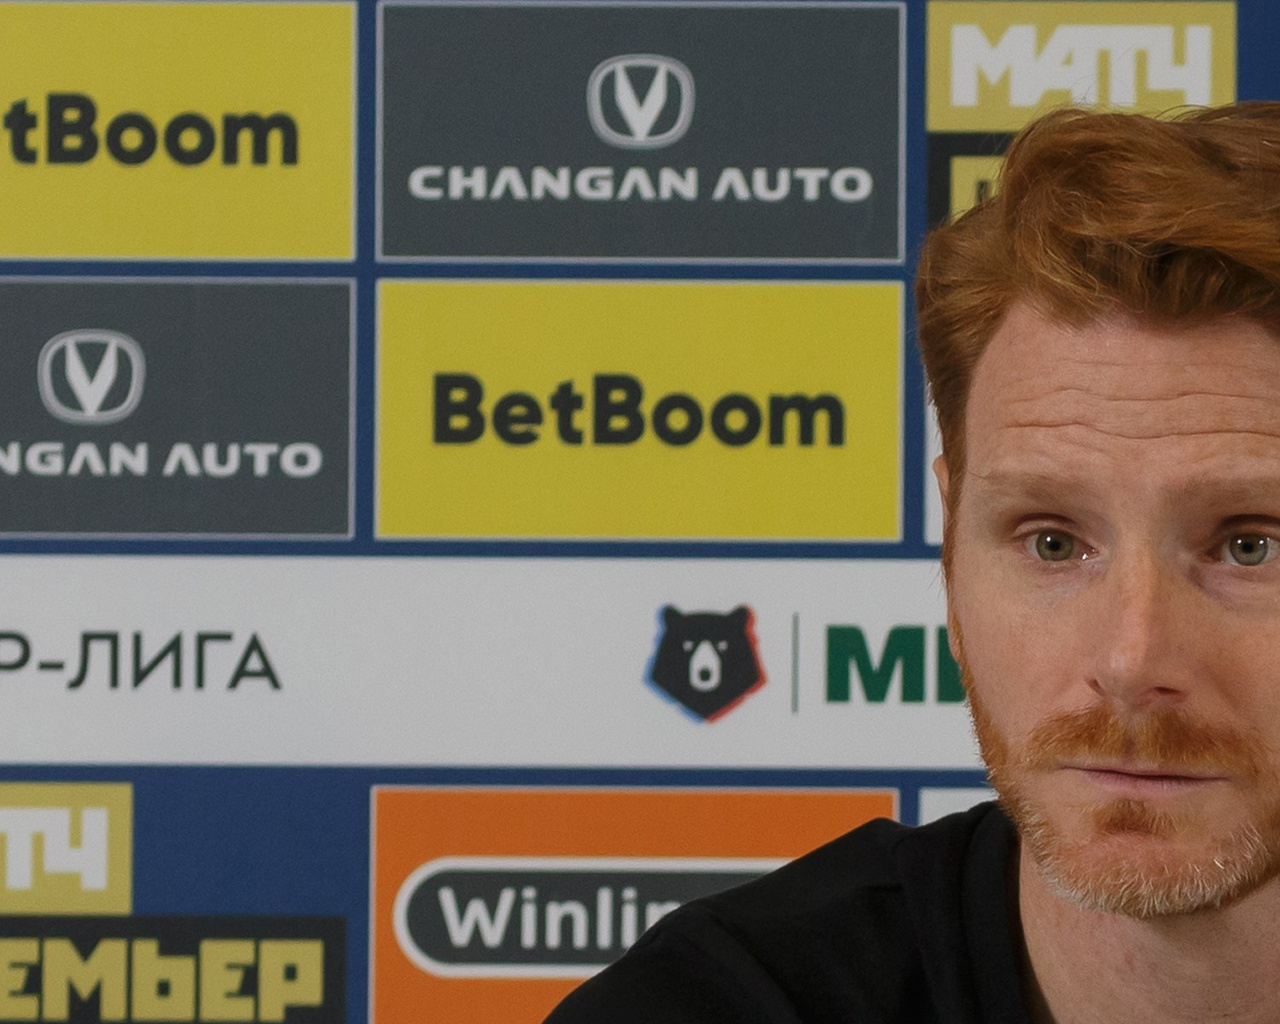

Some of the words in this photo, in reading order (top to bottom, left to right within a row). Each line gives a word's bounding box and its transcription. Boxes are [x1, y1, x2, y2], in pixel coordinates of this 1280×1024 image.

[951, 25, 1212, 106] МАТЧ
[3, 93, 298, 166] tBoom
[409, 167, 697, 200] CHANGAN
[714, 168, 872, 201] AUTO
[433, 373, 845, 447] BetBoom
[163, 443, 322, 477] AUTO
[438, 886, 682, 949] Winli
